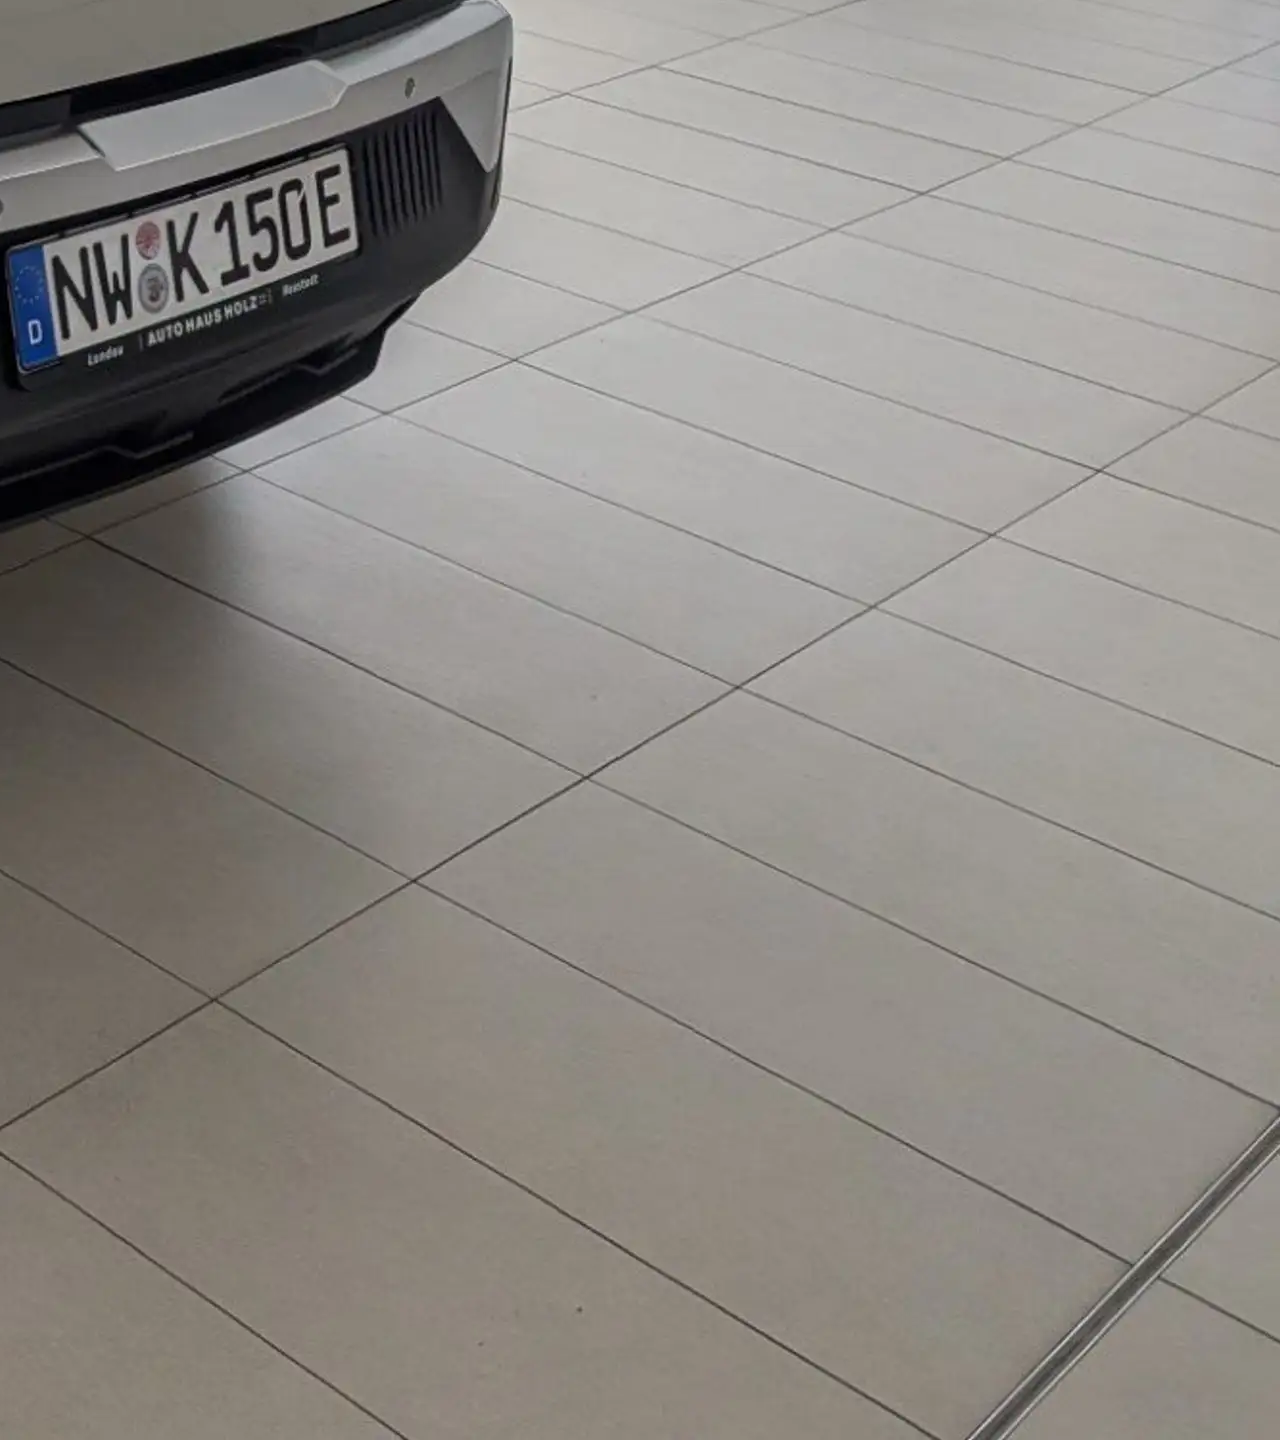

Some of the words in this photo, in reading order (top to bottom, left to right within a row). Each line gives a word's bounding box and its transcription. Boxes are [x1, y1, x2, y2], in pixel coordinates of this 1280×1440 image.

[51, 233, 134, 340] NW
[28, 320, 43, 345] D
[87, 345, 124, 367] Landau
[224, 295, 258, 319] HOLZ
